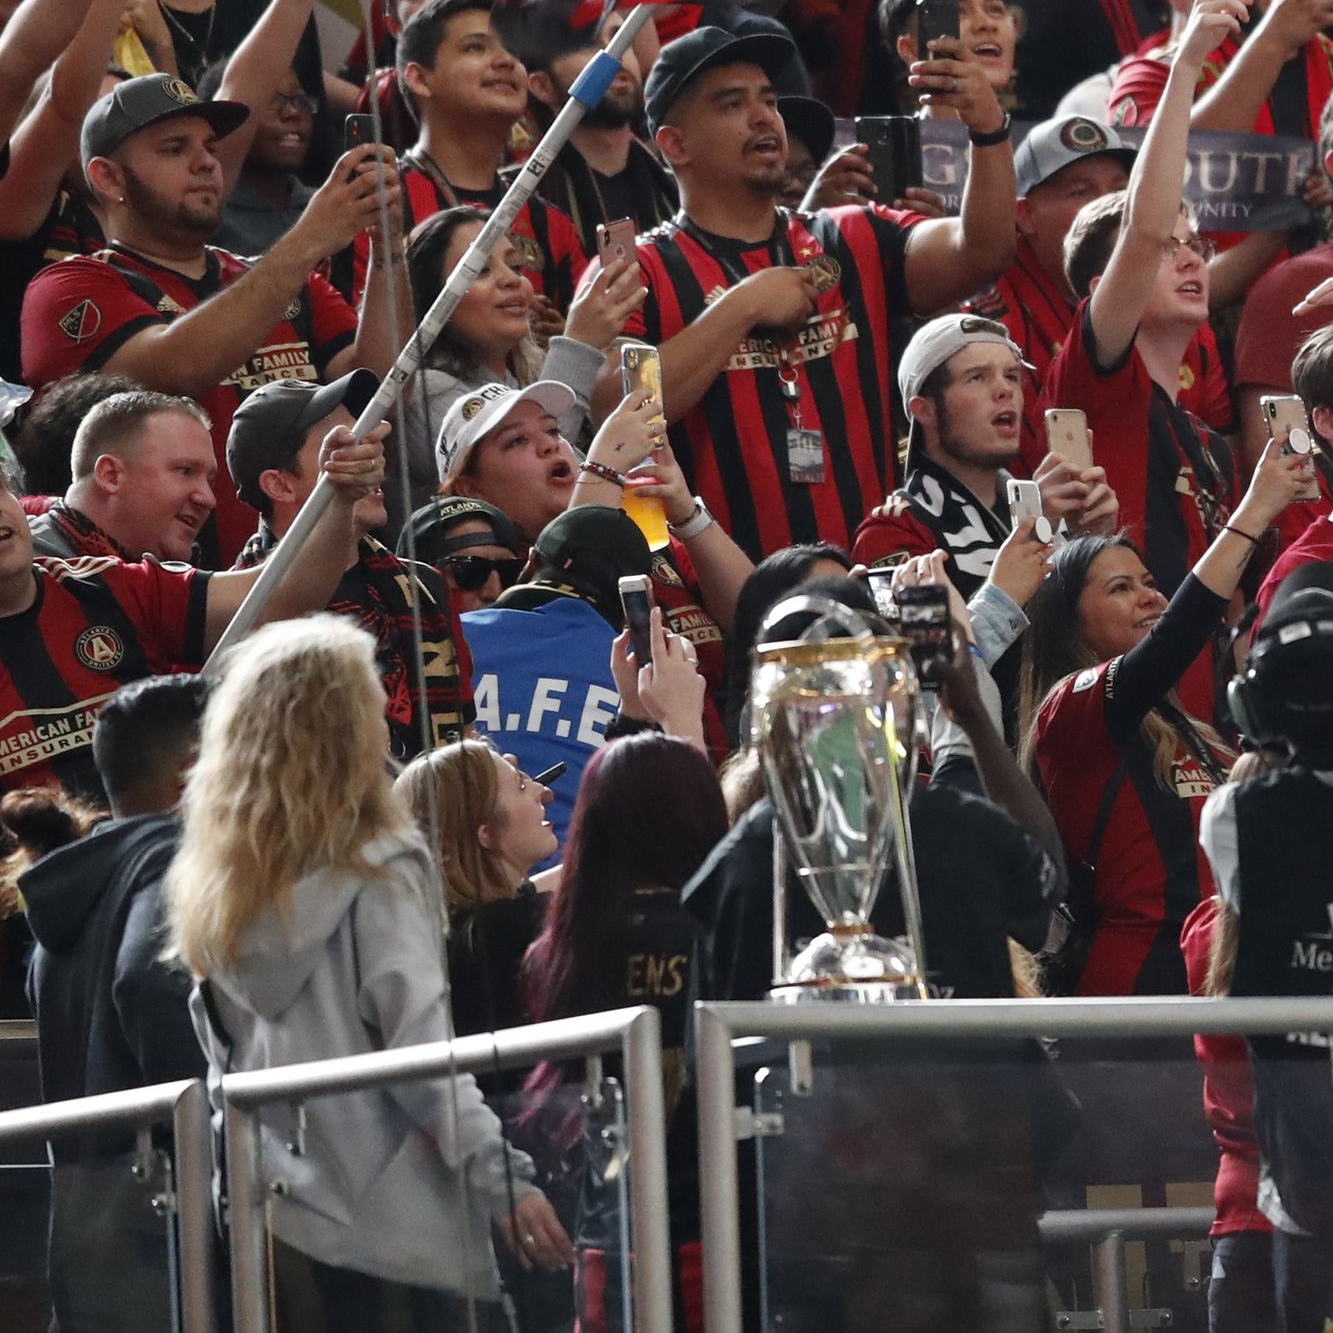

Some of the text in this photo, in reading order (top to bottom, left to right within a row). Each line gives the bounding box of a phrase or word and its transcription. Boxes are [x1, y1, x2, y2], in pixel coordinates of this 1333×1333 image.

[61, 309, 83, 328] MLS
[256, 349, 311, 372] FAMILY
[80, 626, 111, 646] ATLANTA
[87, 657, 116, 669] UNITED
